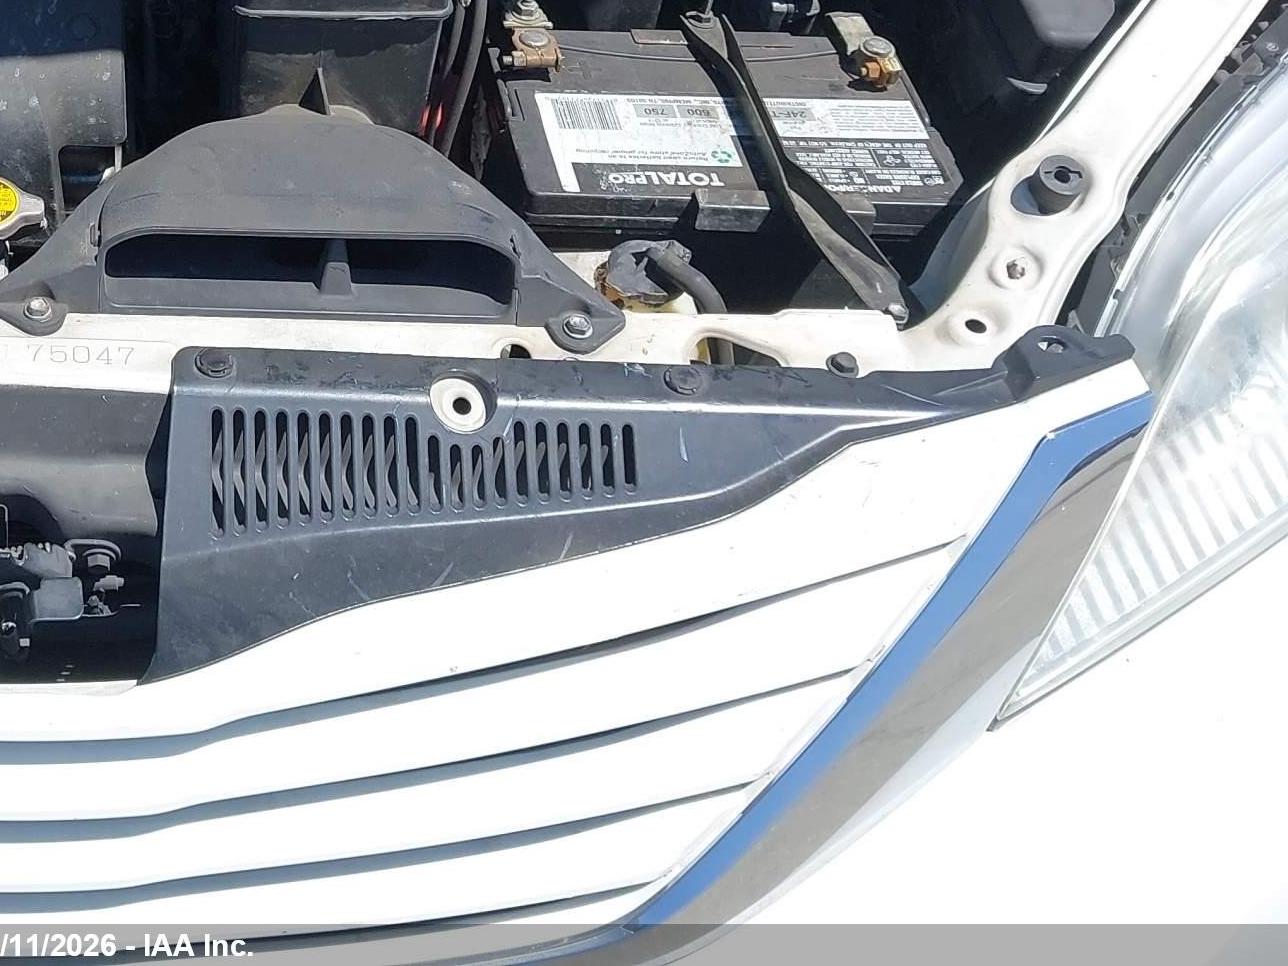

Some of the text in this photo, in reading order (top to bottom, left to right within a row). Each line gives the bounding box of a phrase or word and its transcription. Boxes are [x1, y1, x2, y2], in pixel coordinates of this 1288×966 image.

[643, 107, 668, 117] 750
[686, 108, 711, 117] 600
[607, 170, 726, 187] TOTALPRO
